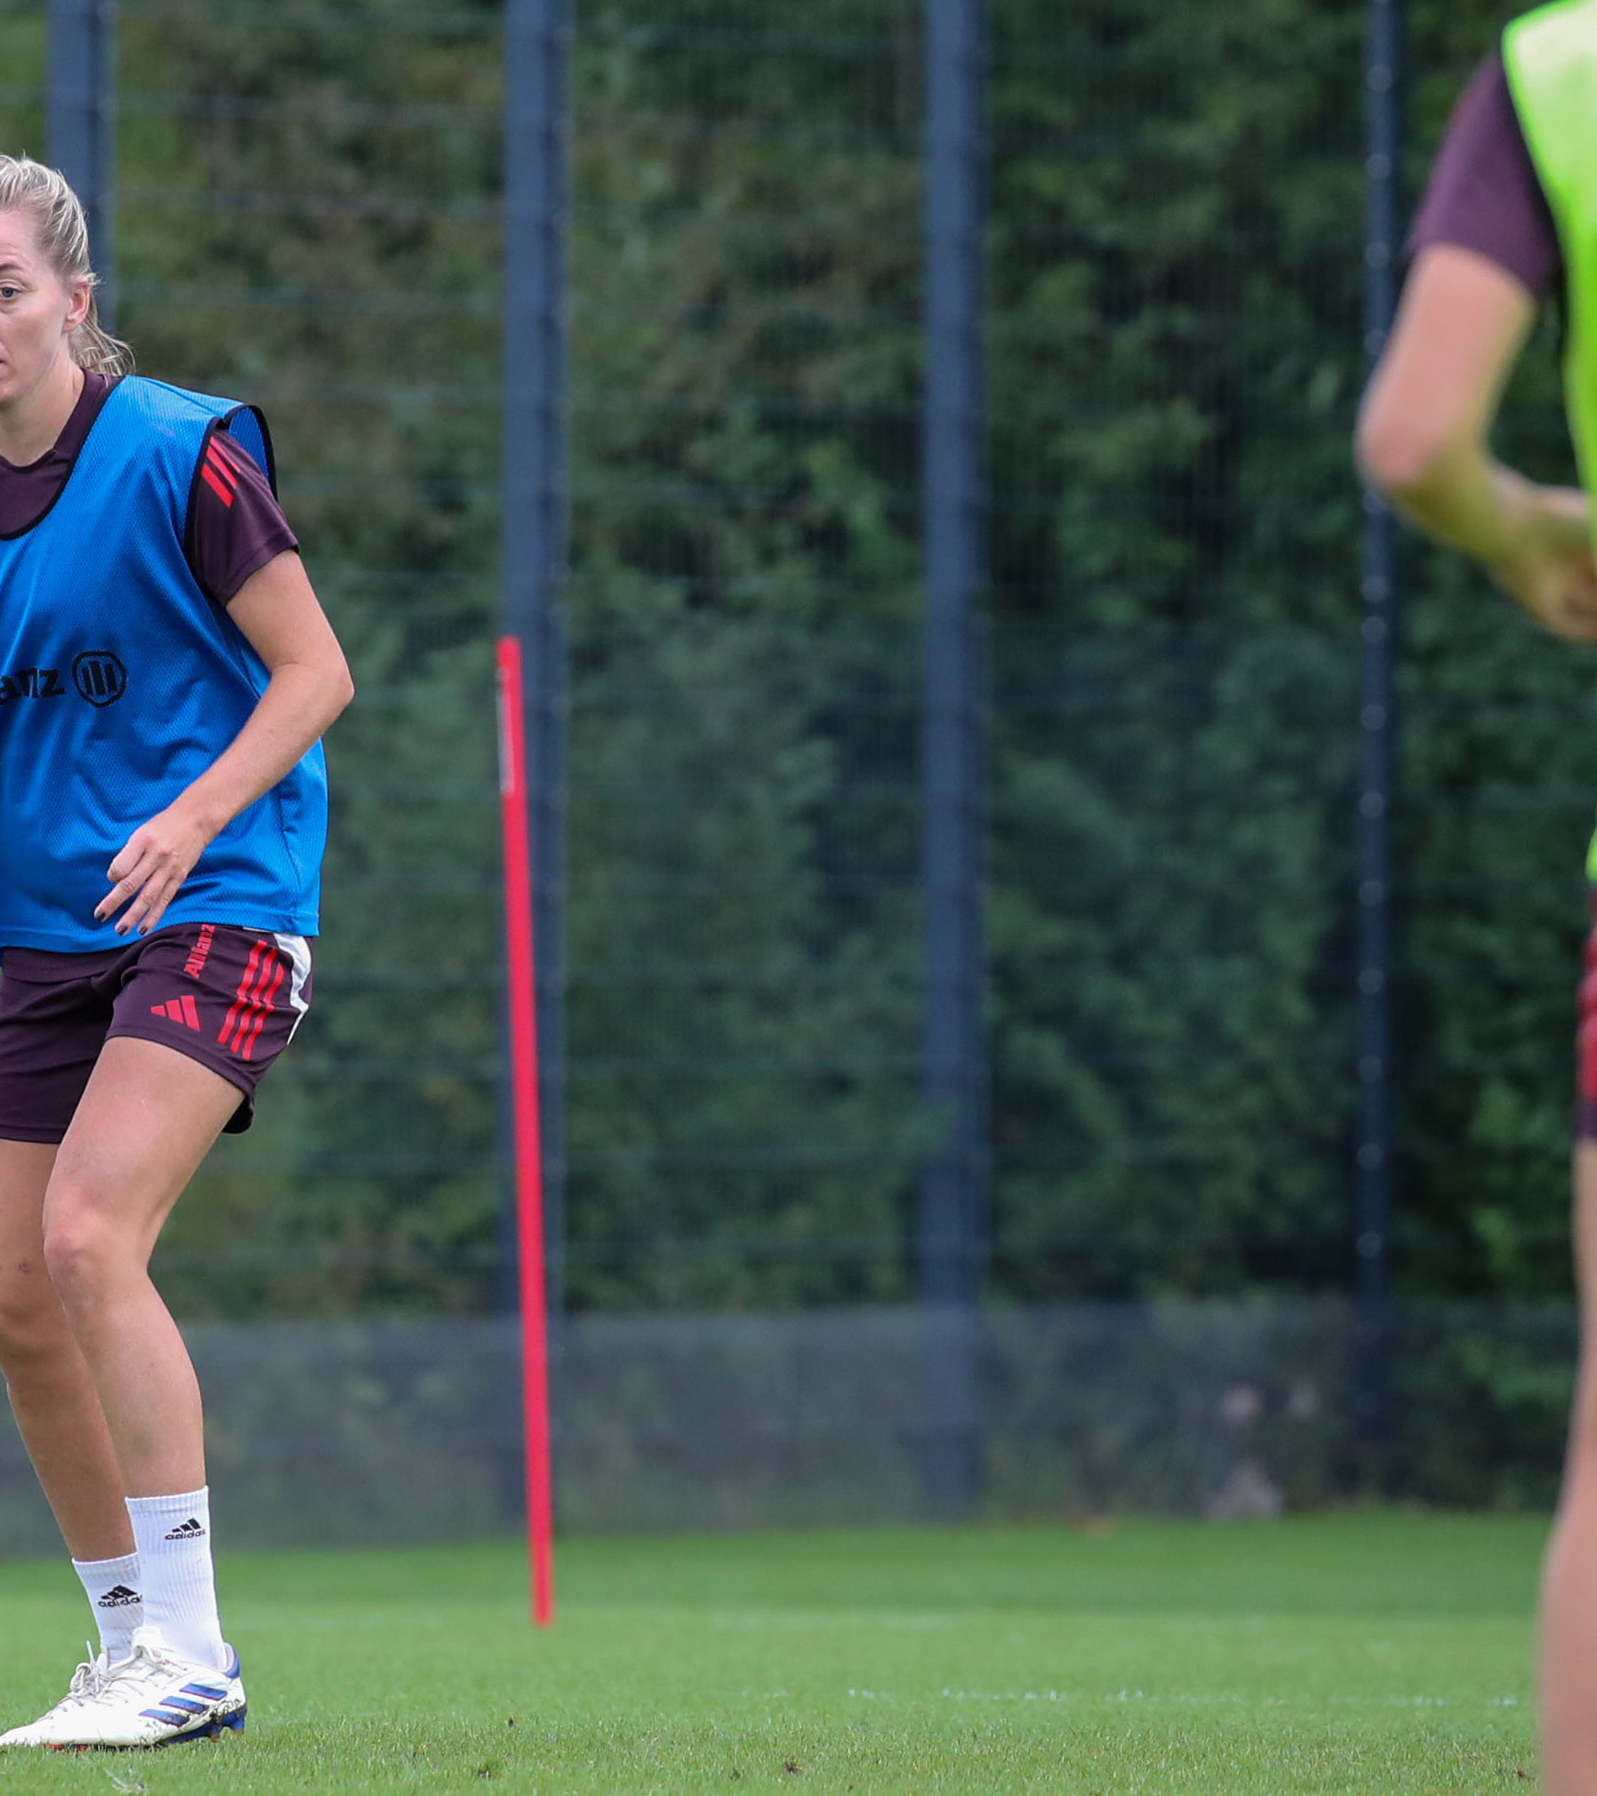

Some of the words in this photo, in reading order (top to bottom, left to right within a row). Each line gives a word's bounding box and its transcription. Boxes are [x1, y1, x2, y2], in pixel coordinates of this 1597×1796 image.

[184, 924, 215, 979] Allianz
[164, 1529, 206, 1540] adidas
[98, 1595, 143, 1608] adida
